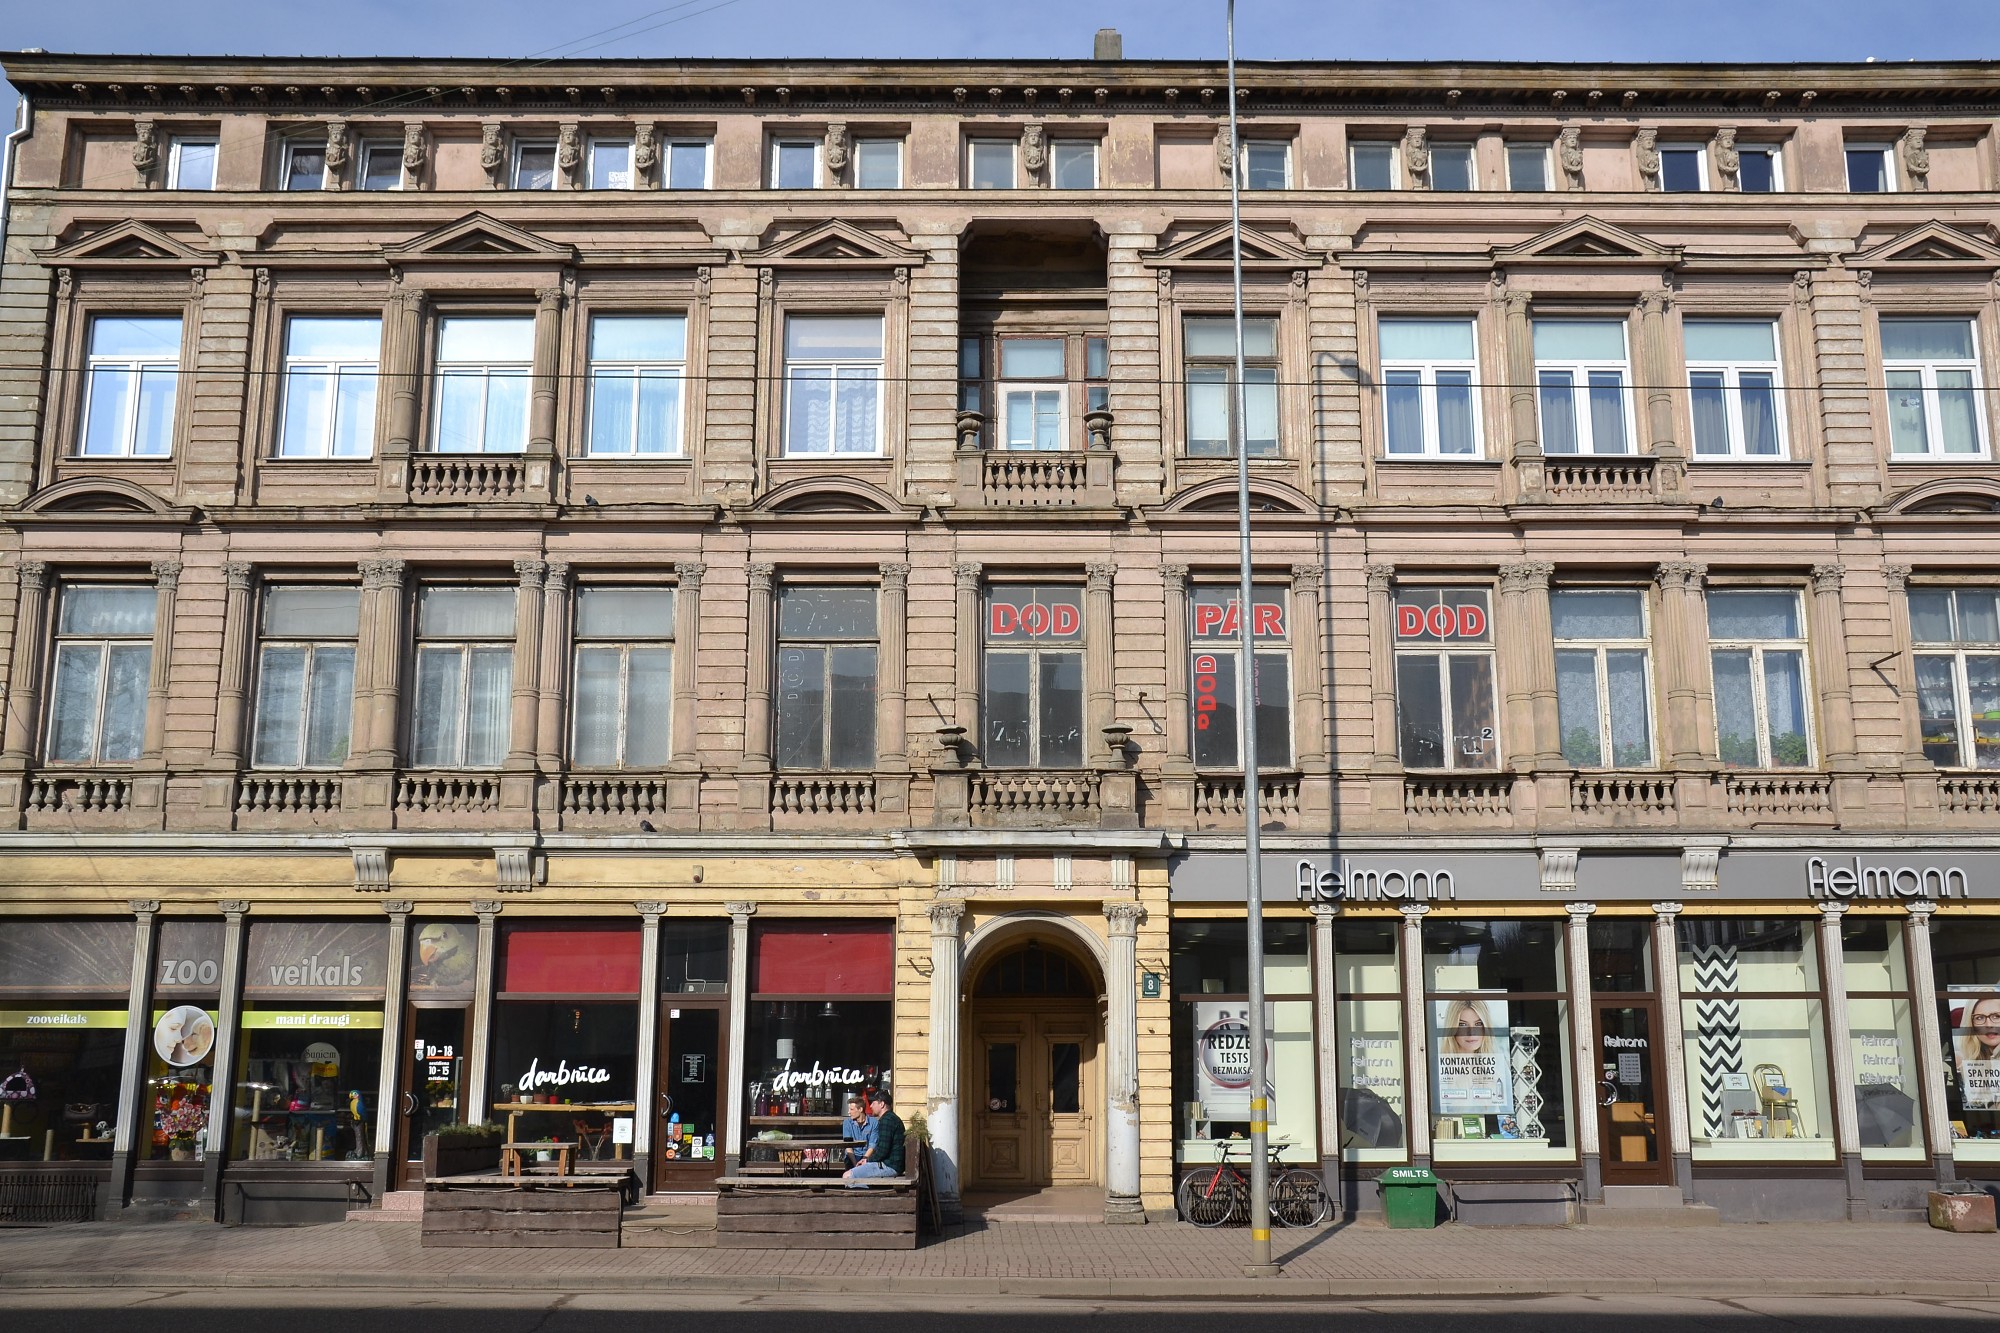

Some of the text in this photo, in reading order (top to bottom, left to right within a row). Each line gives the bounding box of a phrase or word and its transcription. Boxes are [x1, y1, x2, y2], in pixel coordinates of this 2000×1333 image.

[990, 602, 1081, 637] DOD
[1396, 604, 1487, 638] DOD
[1296, 858, 1456, 899] fielmann
[1806, 856, 1969, 897] fielmann
[270, 955, 363, 987] veikals
[1147, 979, 1154, 990] 8
[26, 1014, 88, 1024] zooveikals
[275, 1014, 351, 1027] mani draugi
[1208, 1034, 1251, 1050] REDZE
[1220, 1052, 1249, 1064] TESTS
[519, 1057, 610, 1090] darbnīca
[773, 1058, 865, 1092] darbnīca
[1440, 1066, 1496, 1075] JAUNAS CENAS
[1967, 1069, 1983, 1078] SPA
[1392, 1169, 1429, 1178] SMILTS
